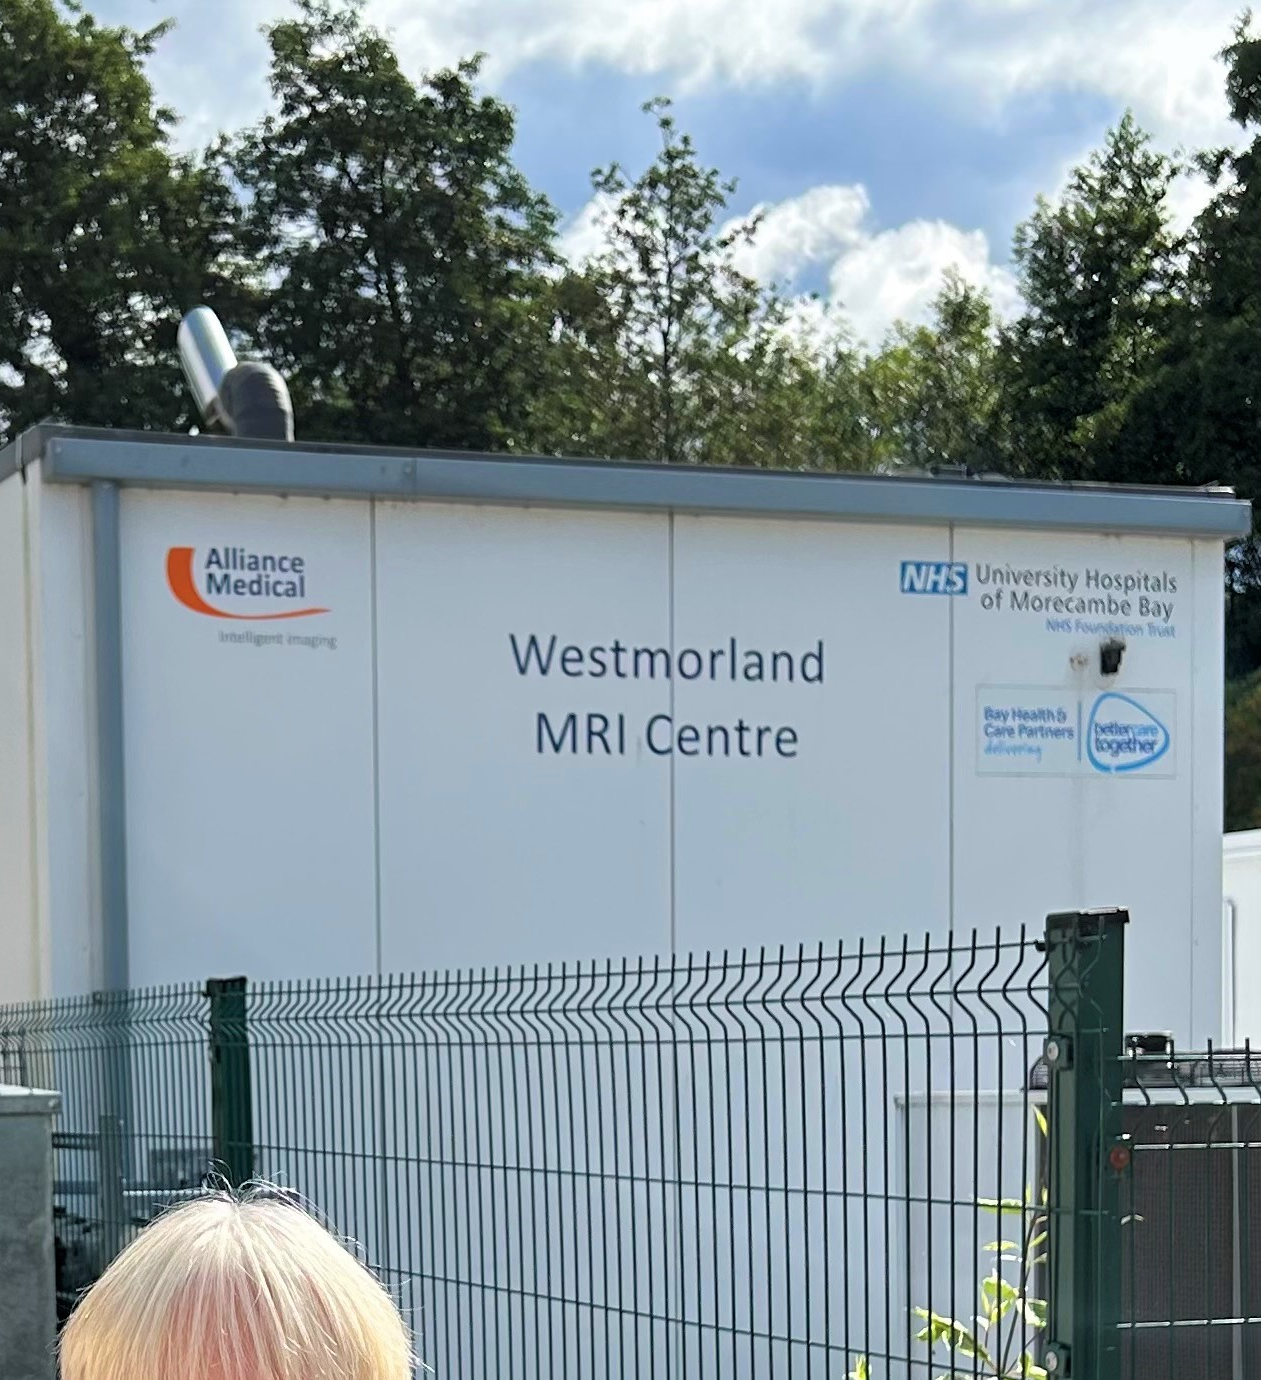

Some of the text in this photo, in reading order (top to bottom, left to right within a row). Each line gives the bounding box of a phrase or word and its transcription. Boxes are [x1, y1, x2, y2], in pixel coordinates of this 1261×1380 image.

[205, 548, 304, 573] Alliance
[206, 573, 306, 598] Medical
[902, 563, 966, 593] NHS
[976, 563, 1178, 595] University Hospitals
[980, 588, 1174, 623] of Morecambe Bay
[1046, 618, 1176, 638] NHS Foundation Trust
[509, 633, 825, 684] Westmorland
[984, 706, 1010, 723] Bay
[1011, 707, 1055, 723] Health
[536, 712, 799, 758] MRI Centre
[984, 724, 1075, 740] Care Partners
[1095, 737, 1157, 757] together
